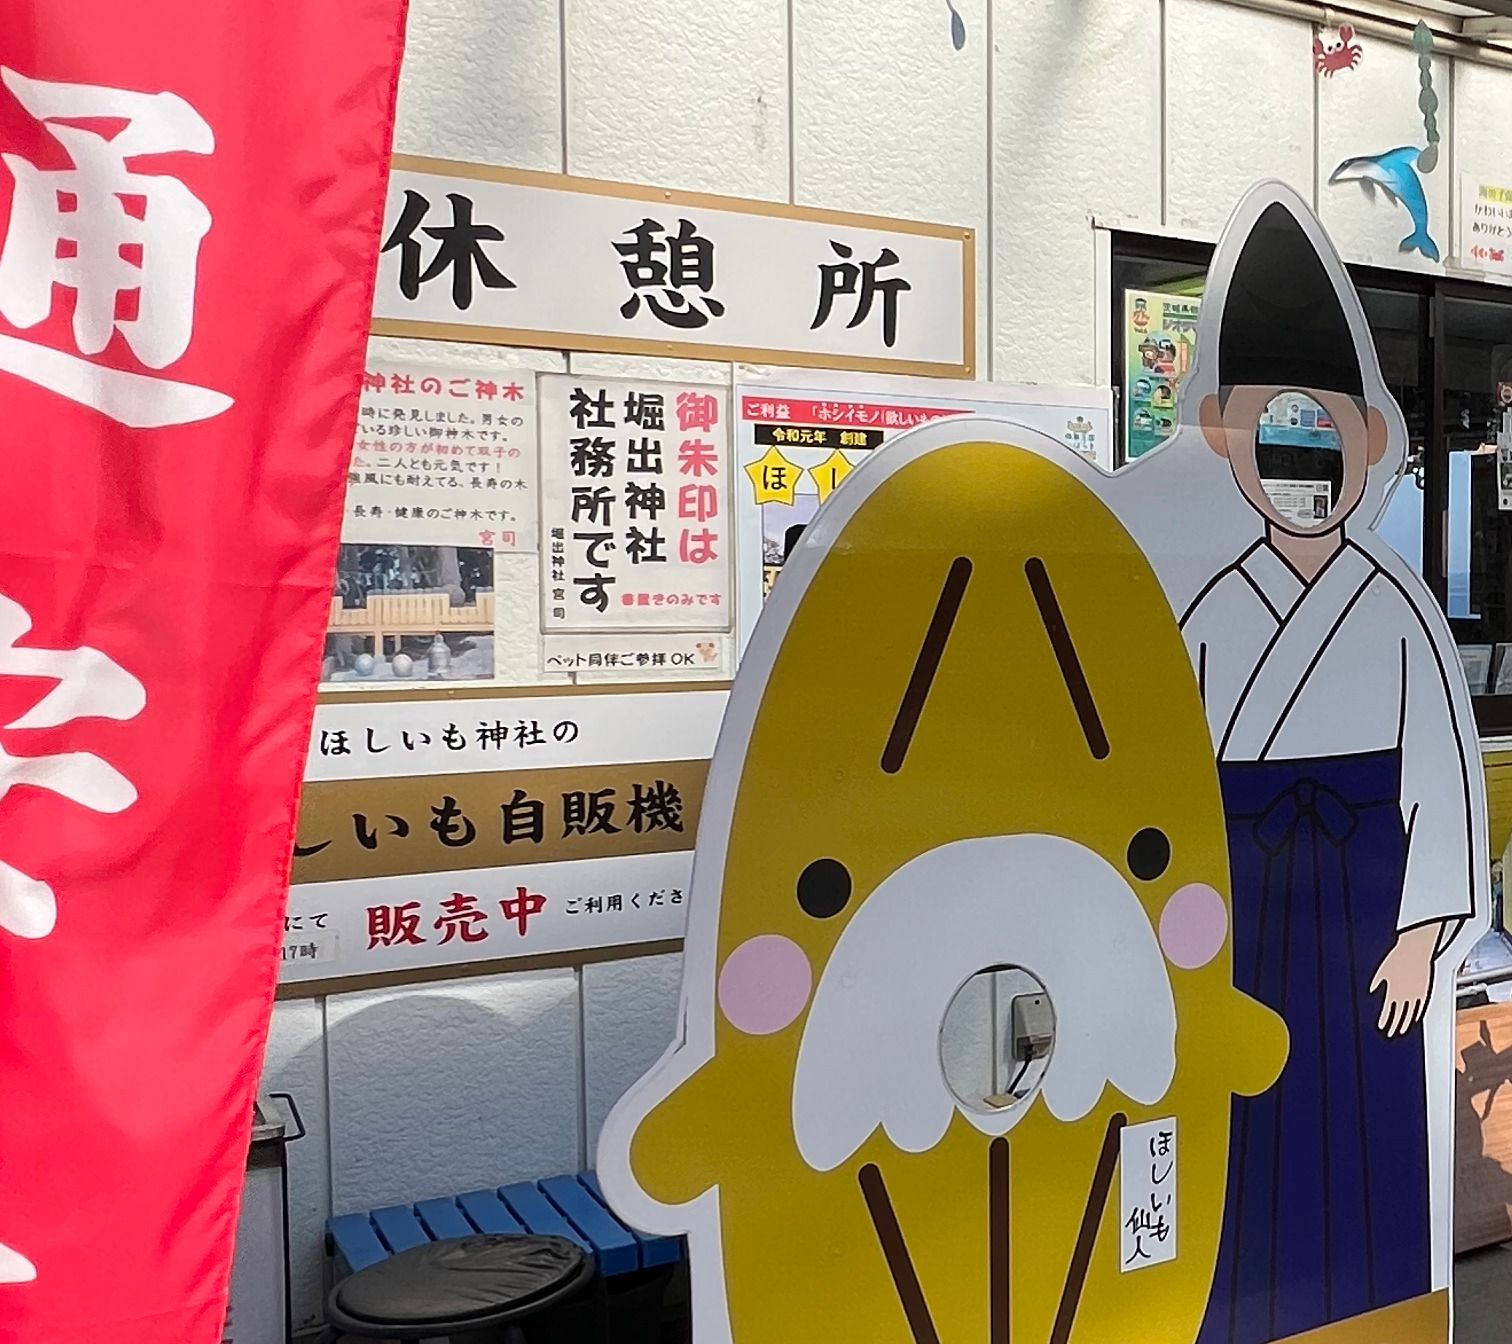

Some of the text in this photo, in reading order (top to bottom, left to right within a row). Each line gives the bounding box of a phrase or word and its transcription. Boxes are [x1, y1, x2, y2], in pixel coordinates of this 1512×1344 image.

[381, 191, 912, 348] 休憩所
[356, 423, 509, 443] いる珍しい御神木です。
[747, 404, 792, 419] ご利益
[772, 427, 868, 446] 令和元年 創建
[569, 387, 617, 613] 社務所です
[623, 391, 668, 565] 堀出神社
[675, 391, 719, 565] 御朱印は
[762, 465, 788, 490] ほ
[479, 530, 517, 547] 宮司
[320, 720, 580, 756] ほしいも神社の
[366, 886, 548, 951] 販売中
[565, 888, 684, 915] ご利用くださ
[1148, 1130, 1175, 1243] ほしいも
[1125, 1207, 1152, 1263] 仙人
